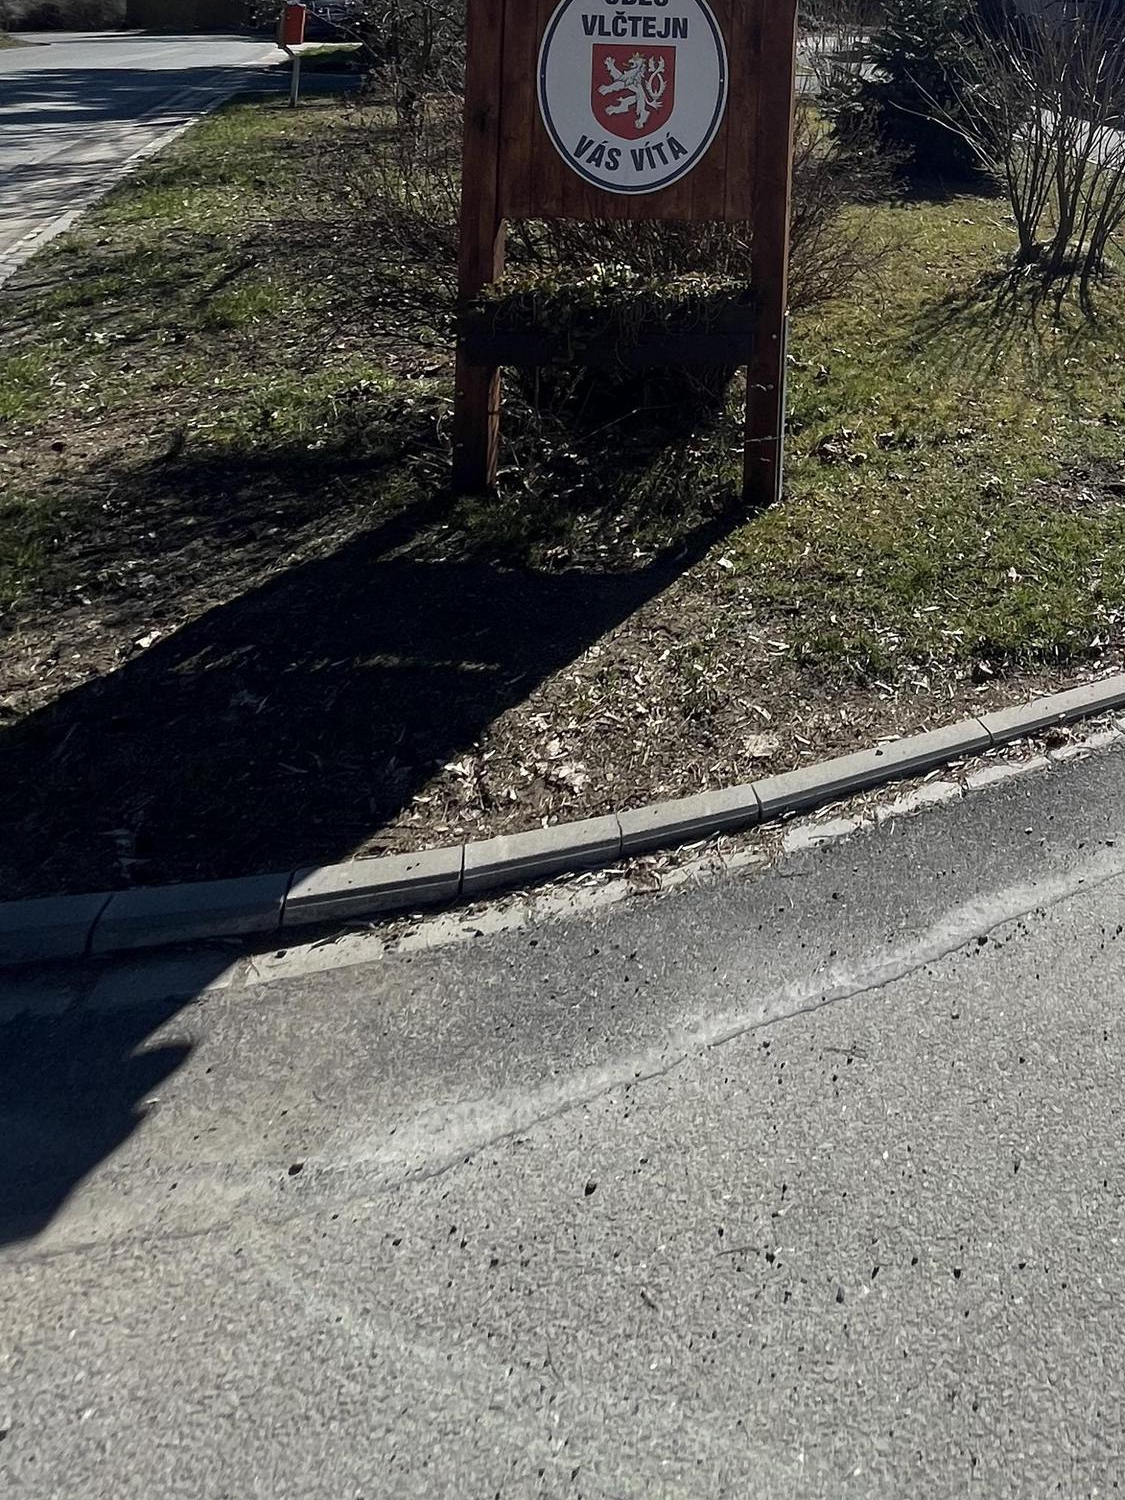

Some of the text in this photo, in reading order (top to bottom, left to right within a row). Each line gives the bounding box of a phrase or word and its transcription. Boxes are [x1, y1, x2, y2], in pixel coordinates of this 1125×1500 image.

[581, 11, 688, 39] VLČTEJN
[573, 132, 688, 171] VÁS VÍTÁ
